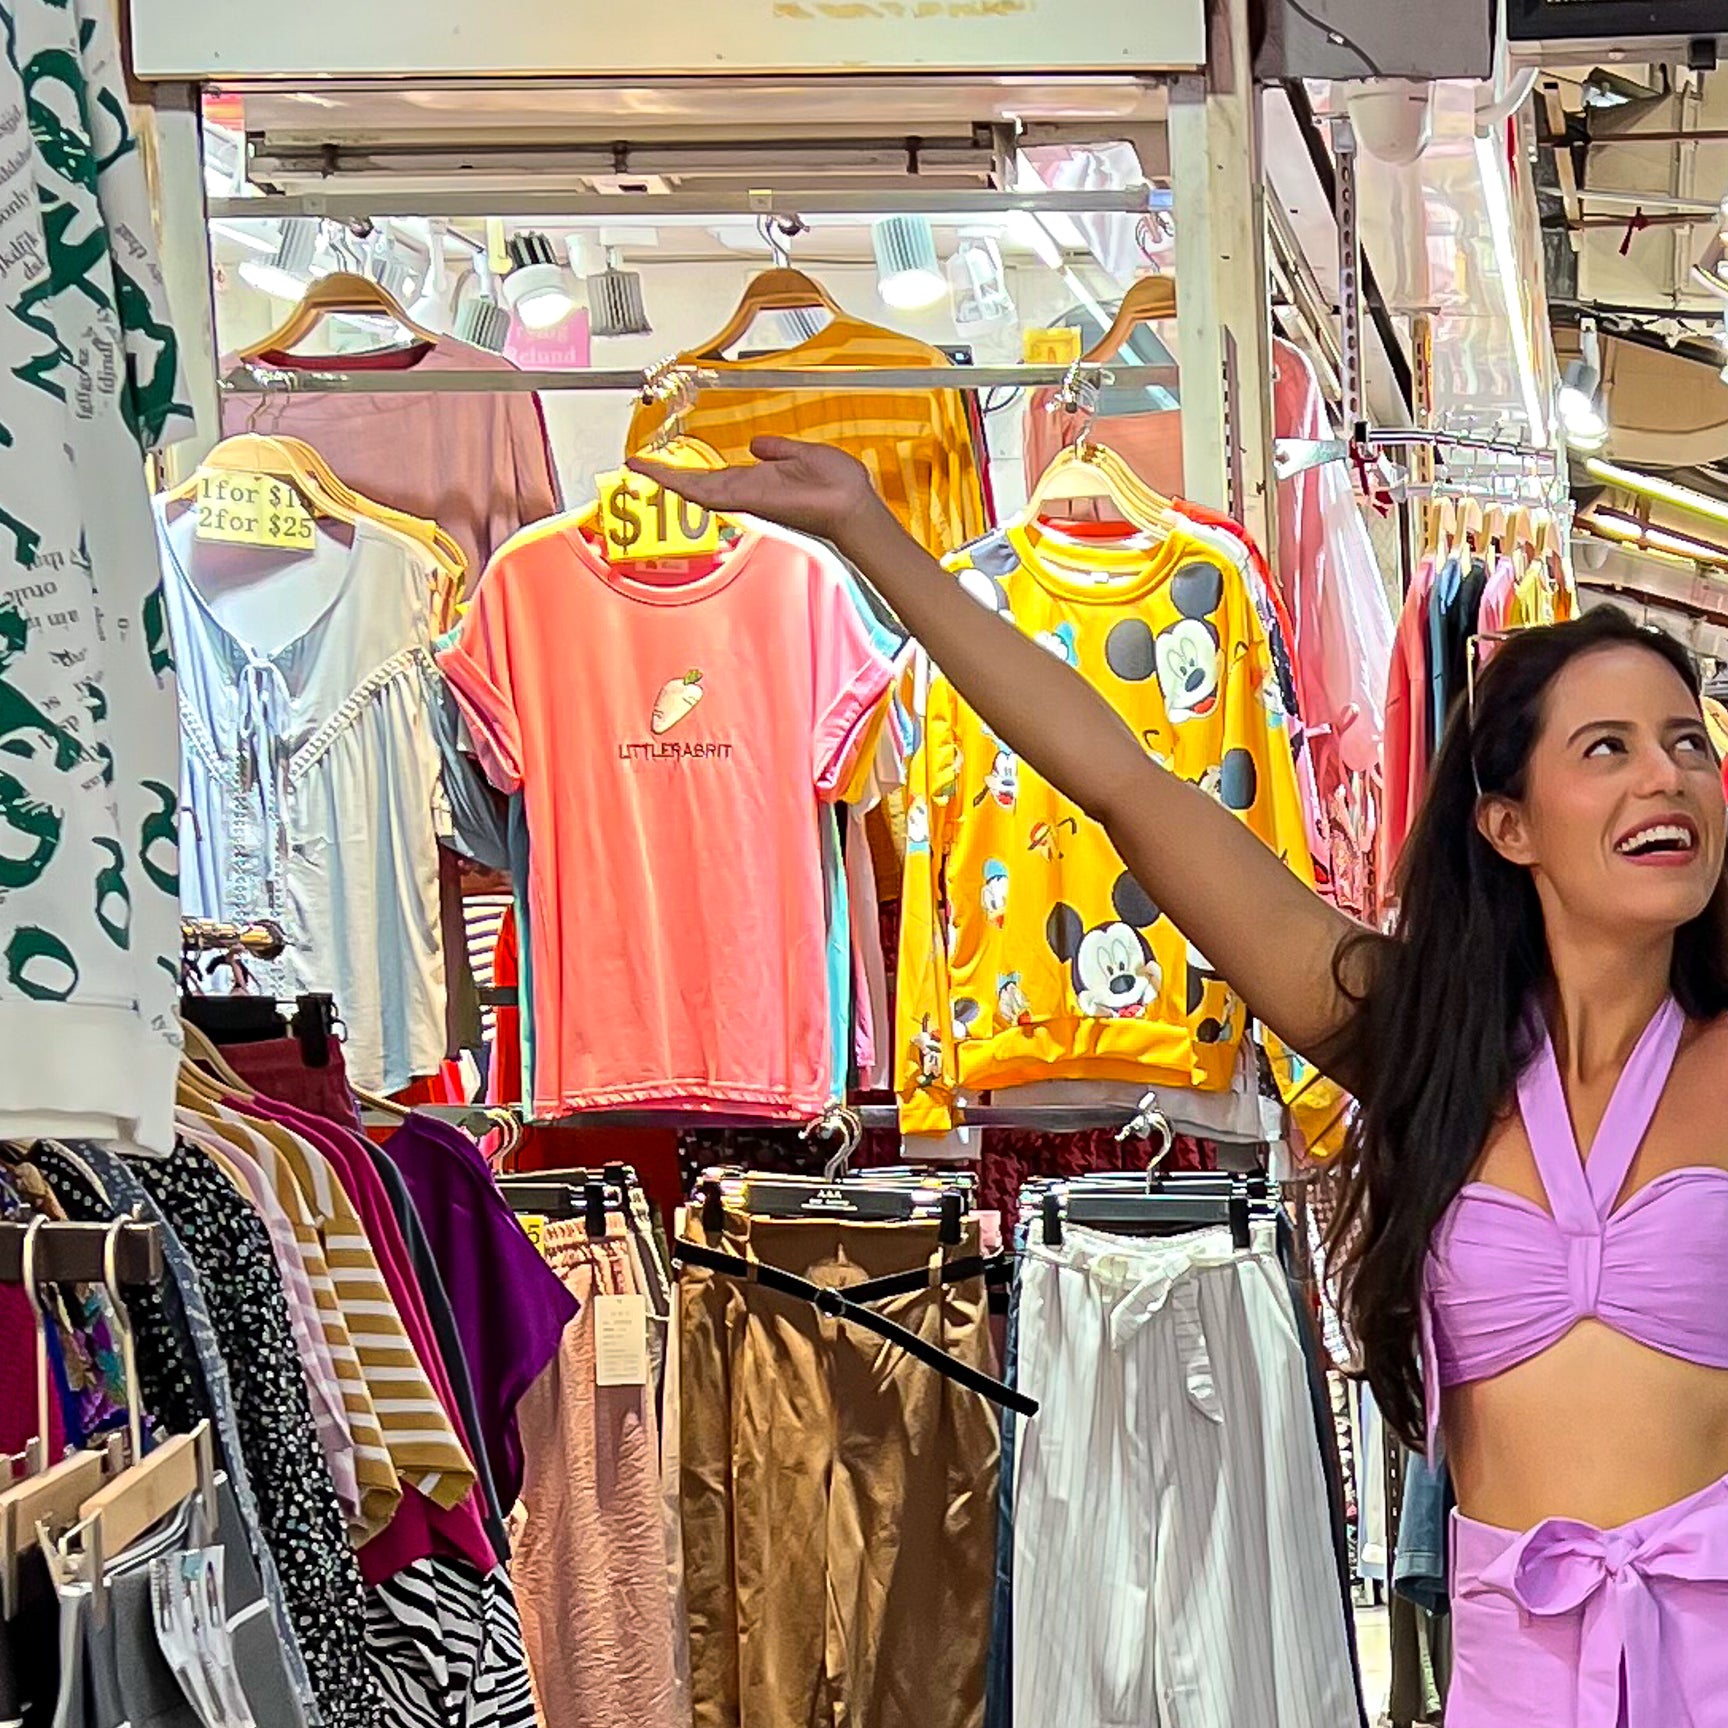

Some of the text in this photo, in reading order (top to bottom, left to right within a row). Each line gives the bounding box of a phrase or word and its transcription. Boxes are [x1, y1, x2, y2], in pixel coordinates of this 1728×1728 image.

[268, 484, 297, 509] $1
[268, 513, 312, 538] $25
[609, 478, 710, 556] $10
